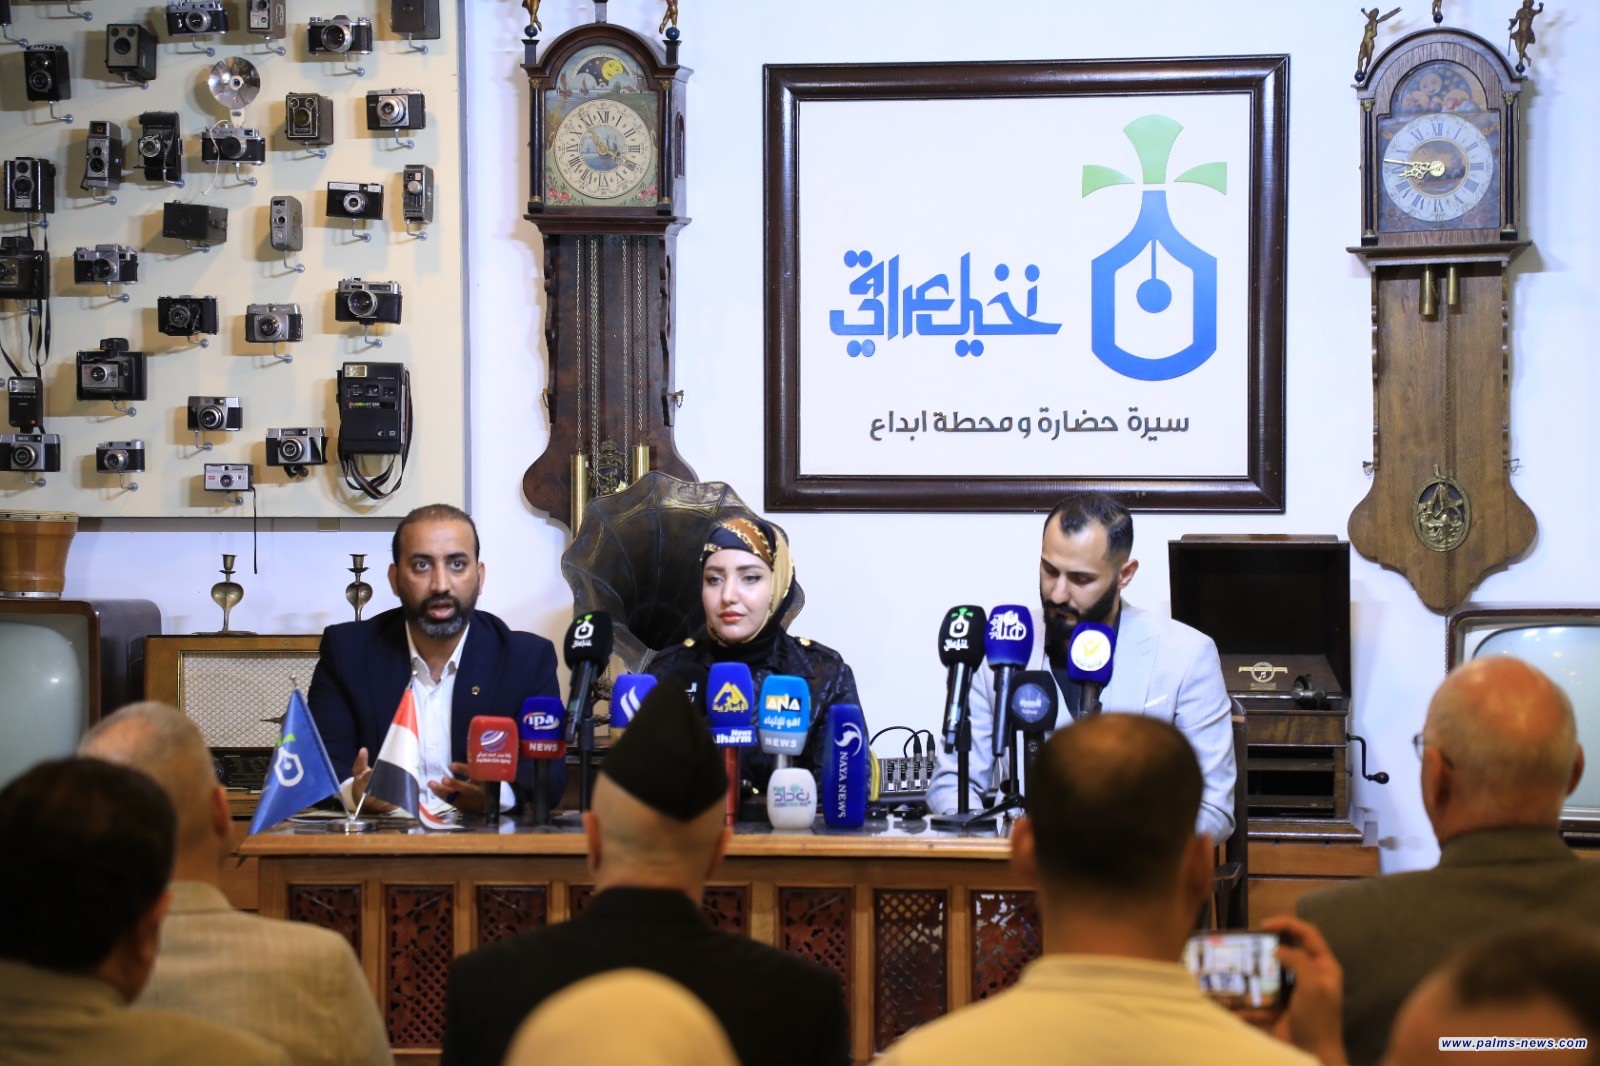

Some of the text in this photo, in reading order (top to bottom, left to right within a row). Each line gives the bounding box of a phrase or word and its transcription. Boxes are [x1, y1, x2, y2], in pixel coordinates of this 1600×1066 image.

[870, 409, 928, 441] ابداع
[1038, 406, 1119, 441] حضارة
[1127, 406, 1190, 441] سيرة
[528, 713, 554, 730] ipa
[529, 743, 558, 752] NEWS
[713, 734, 752, 744] lharm
[765, 737, 797, 748] NEWS
[837, 751, 849, 819] NAYA NEWS
